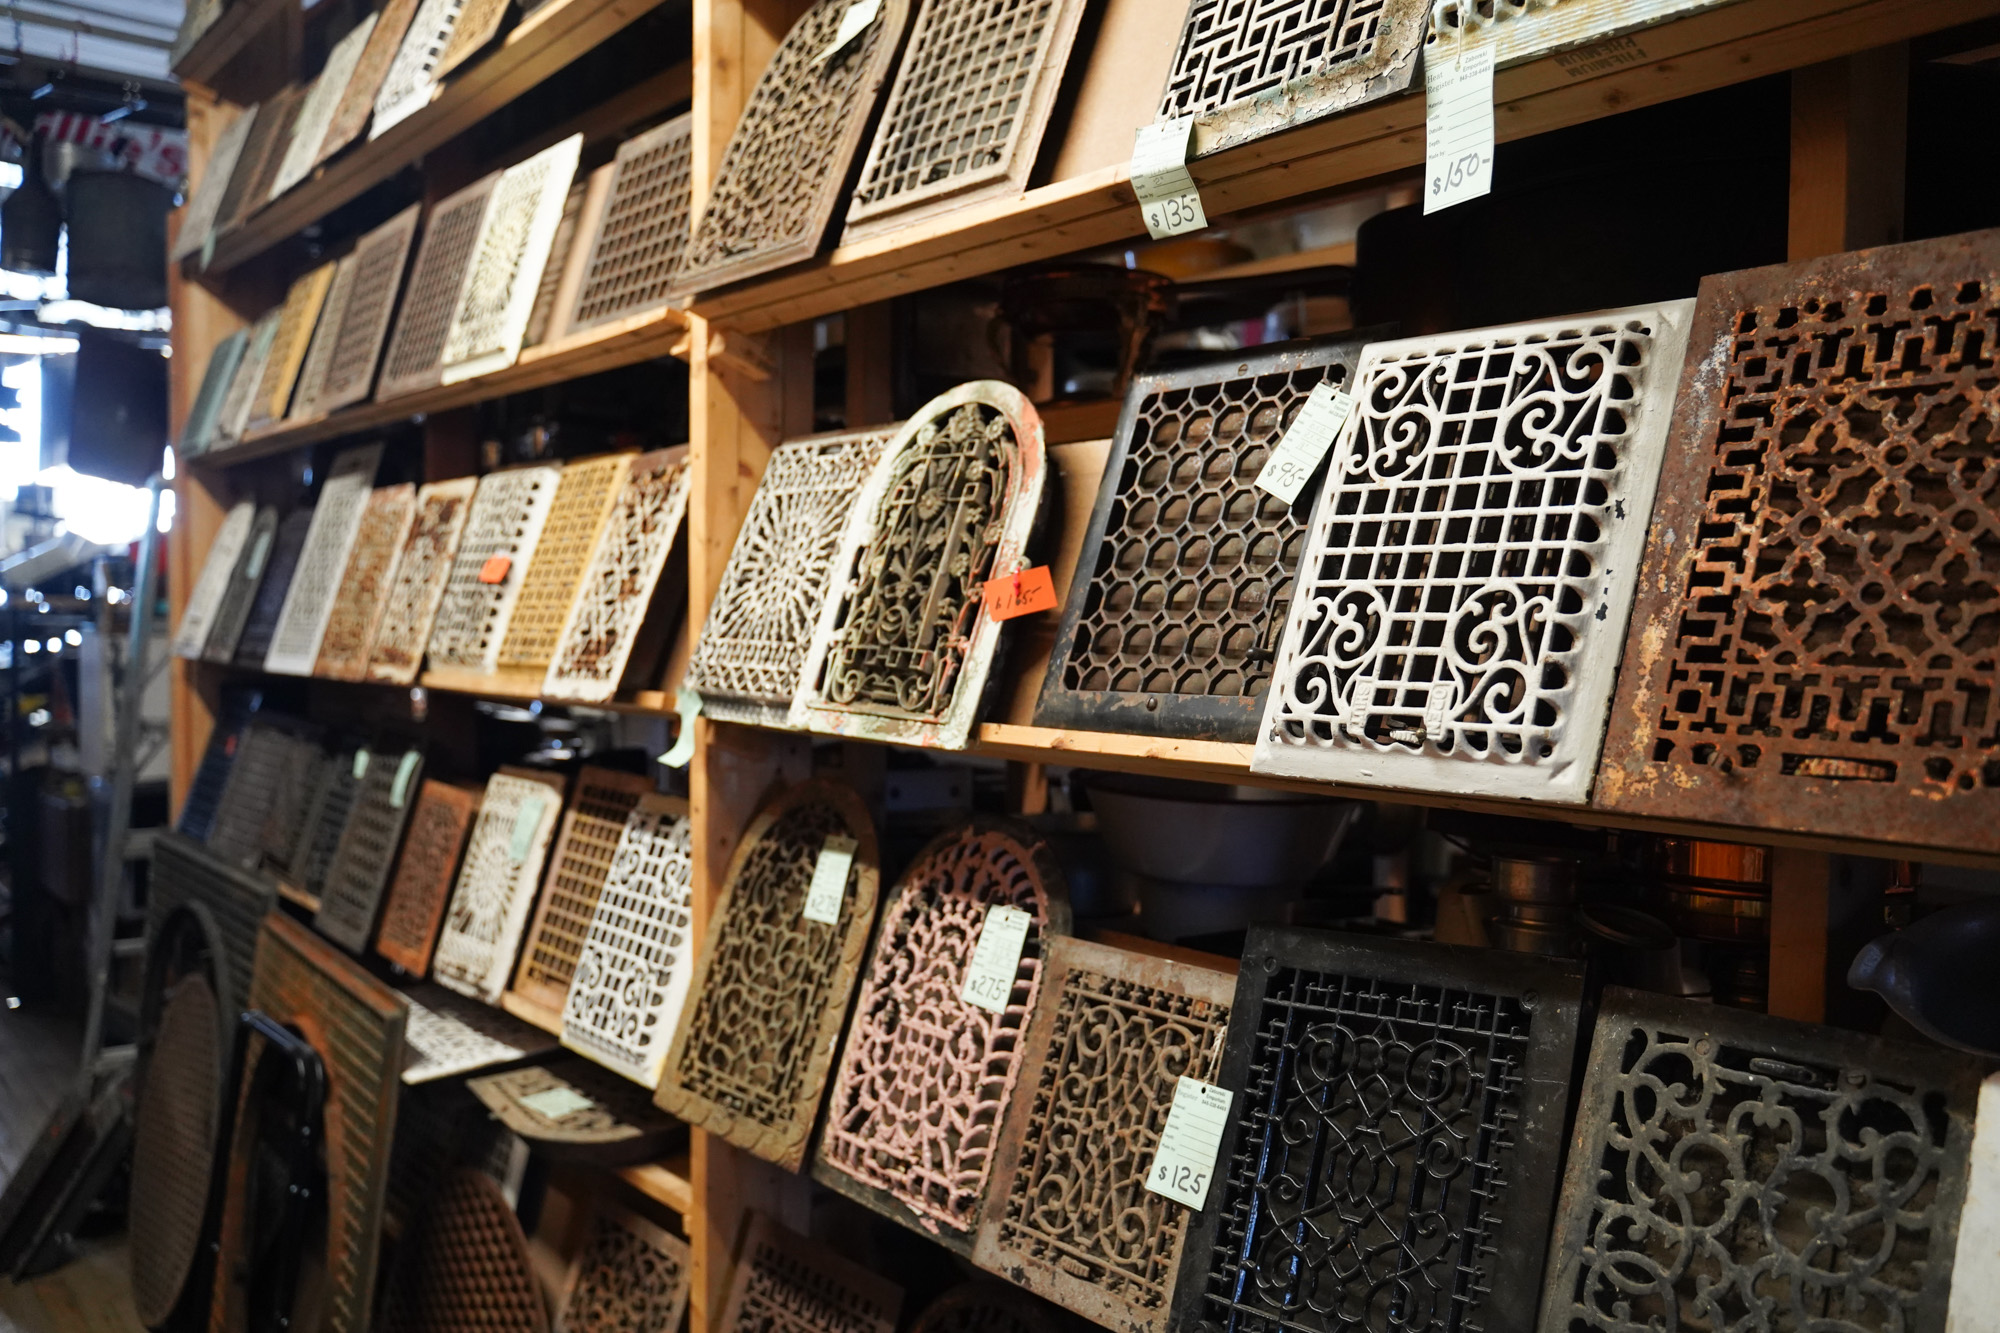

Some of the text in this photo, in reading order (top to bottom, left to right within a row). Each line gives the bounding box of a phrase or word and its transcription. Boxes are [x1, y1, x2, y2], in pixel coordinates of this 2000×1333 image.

[1462, 59, 1489, 73] Emporium
[1427, 72, 1443, 84] Heat
[1427, 78, 1455, 95] Register
